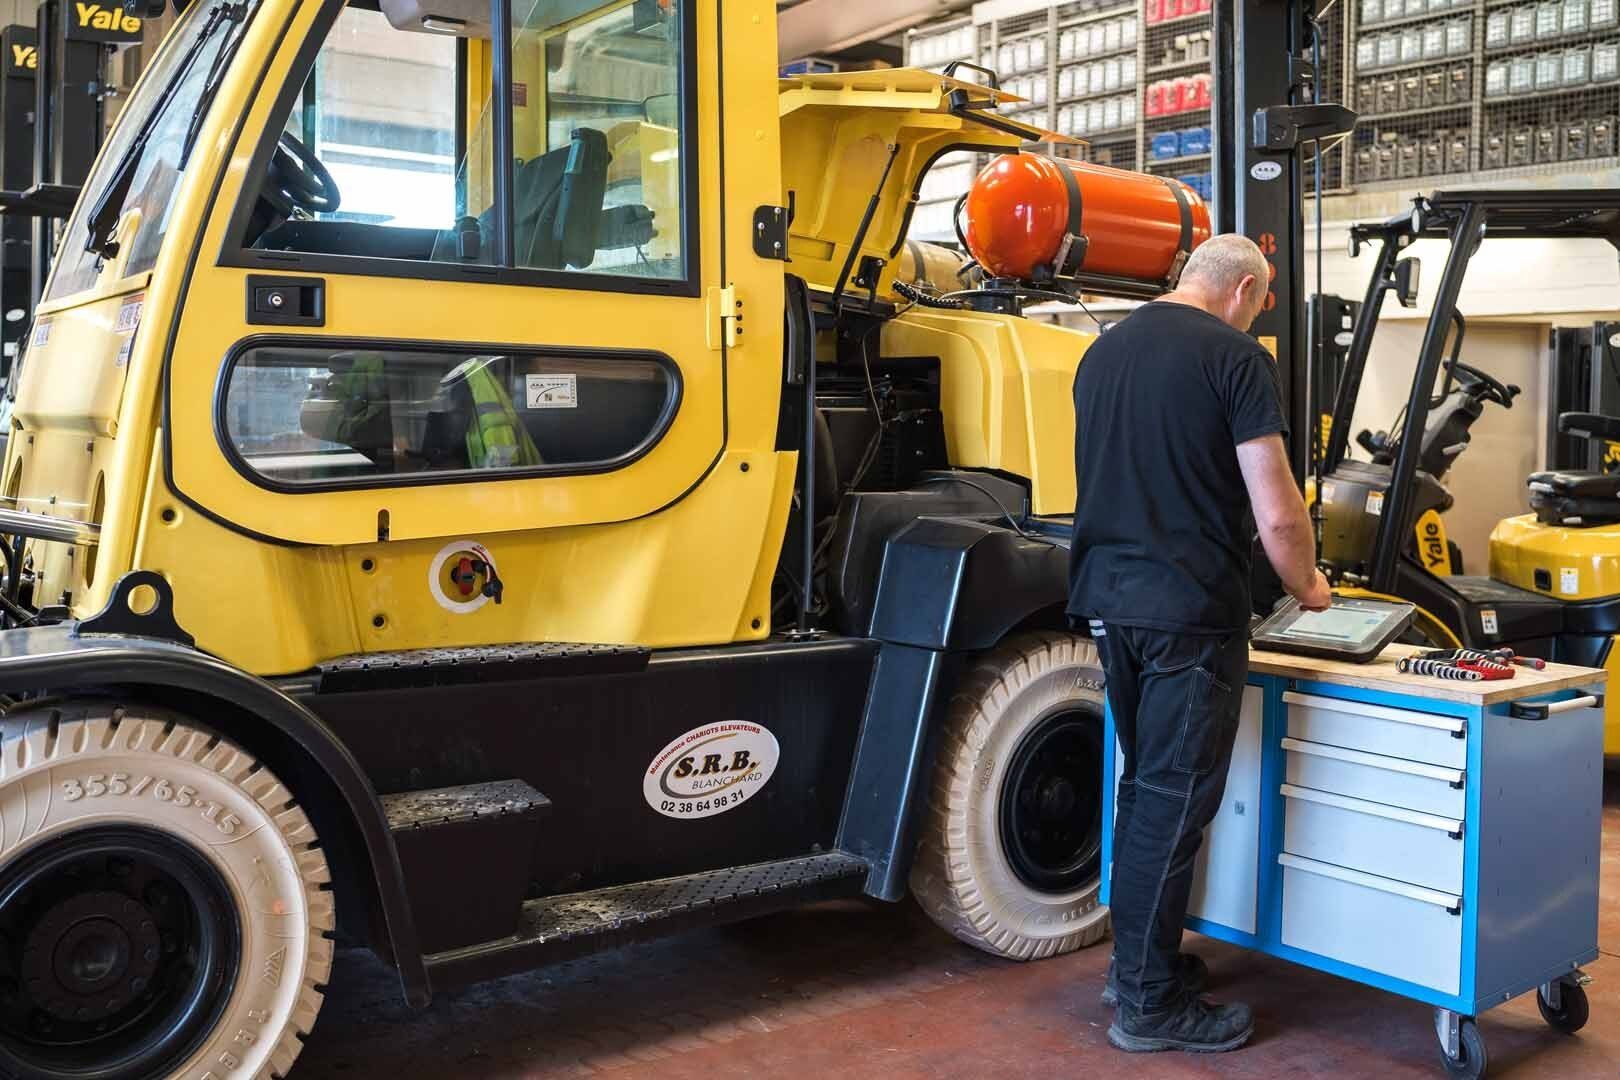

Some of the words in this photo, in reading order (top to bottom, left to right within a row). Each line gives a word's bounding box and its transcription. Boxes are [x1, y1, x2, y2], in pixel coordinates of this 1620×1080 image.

[75, 2, 141, 33] Yale
[1424, 522, 1445, 568] Yale
[650, 741, 686, 775] Maintenance
[686, 726, 719, 743] CHARIOTS
[720, 724, 761, 735] ELEVATEURS
[673, 750, 757, 779] S.R.B.
[691, 772, 763, 790] BLANCHARD
[660, 800, 676, 812] 02
[678, 802, 693, 813] 38
[696, 800, 711, 812] 64
[713, 796, 728, 808] 98
[731, 789, 745, 803] 31
